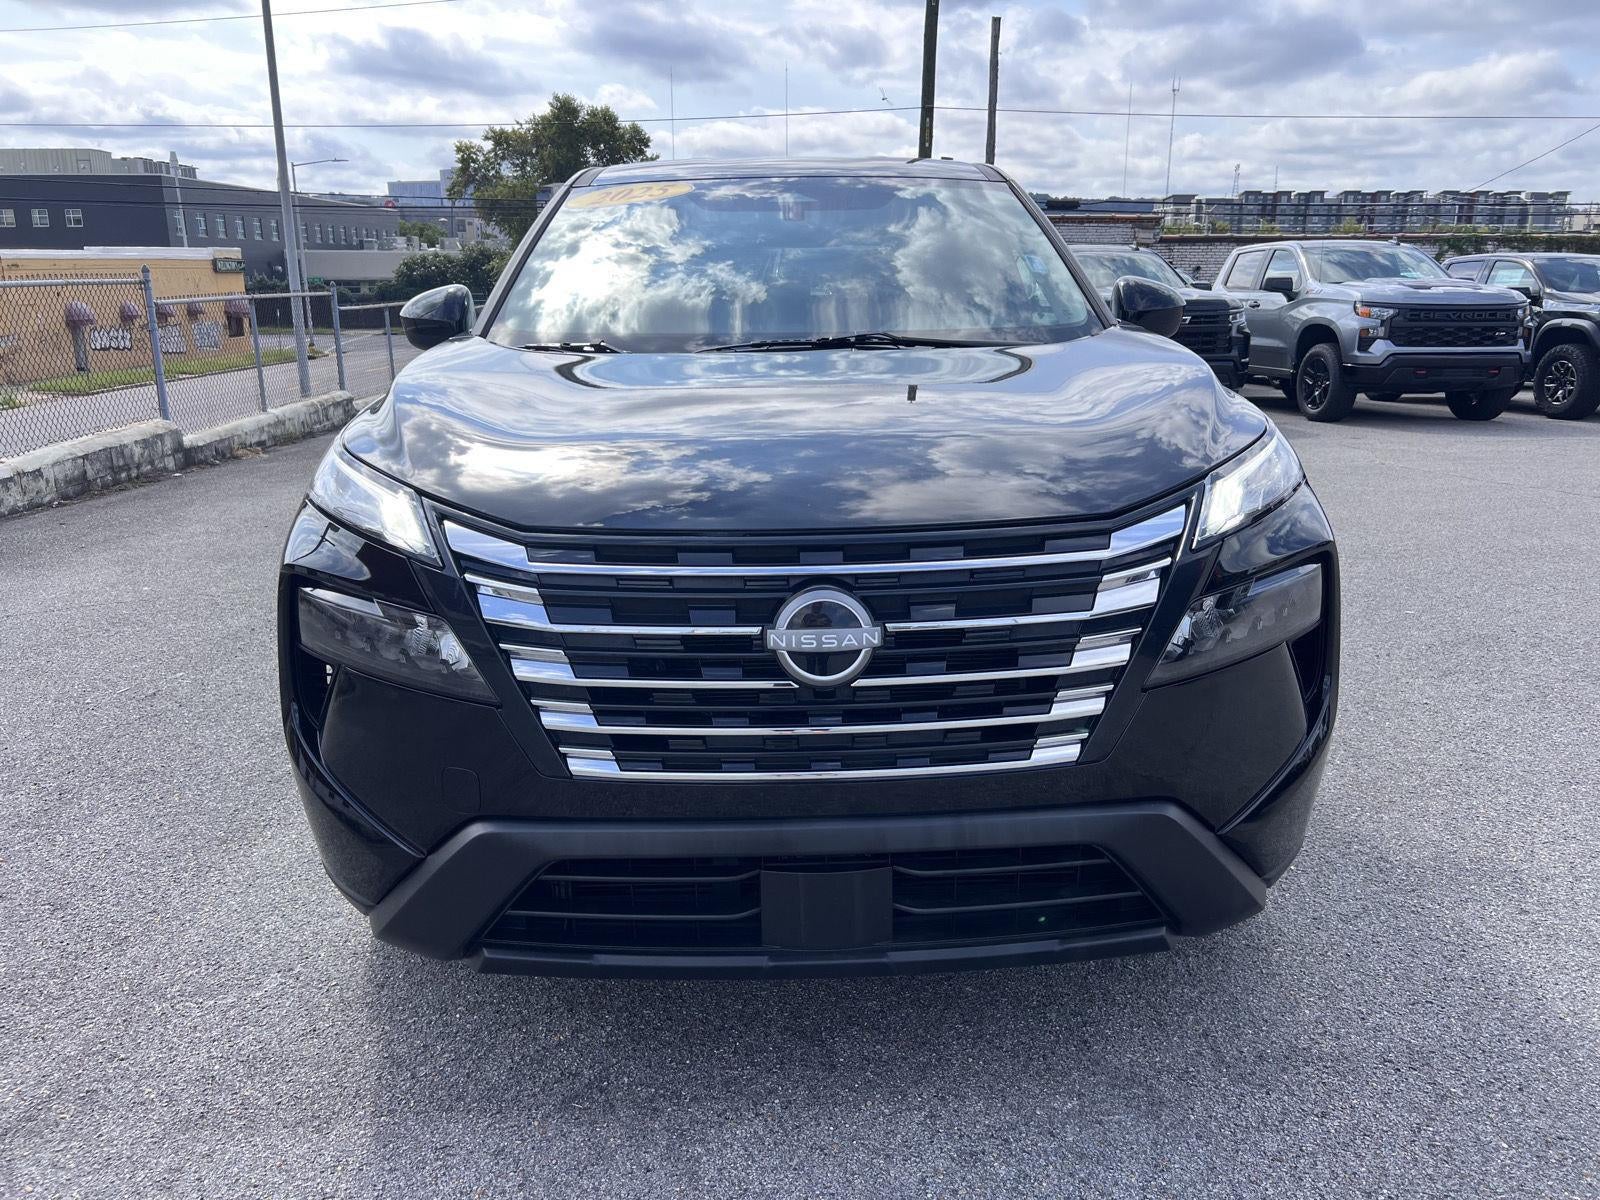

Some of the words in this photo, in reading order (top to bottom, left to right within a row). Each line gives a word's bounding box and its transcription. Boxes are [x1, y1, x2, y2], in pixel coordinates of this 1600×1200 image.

[590, 184, 674, 205] 2025
[1406, 311, 1513, 320] CHEVROLET
[769, 631, 879, 648] NISSAN
